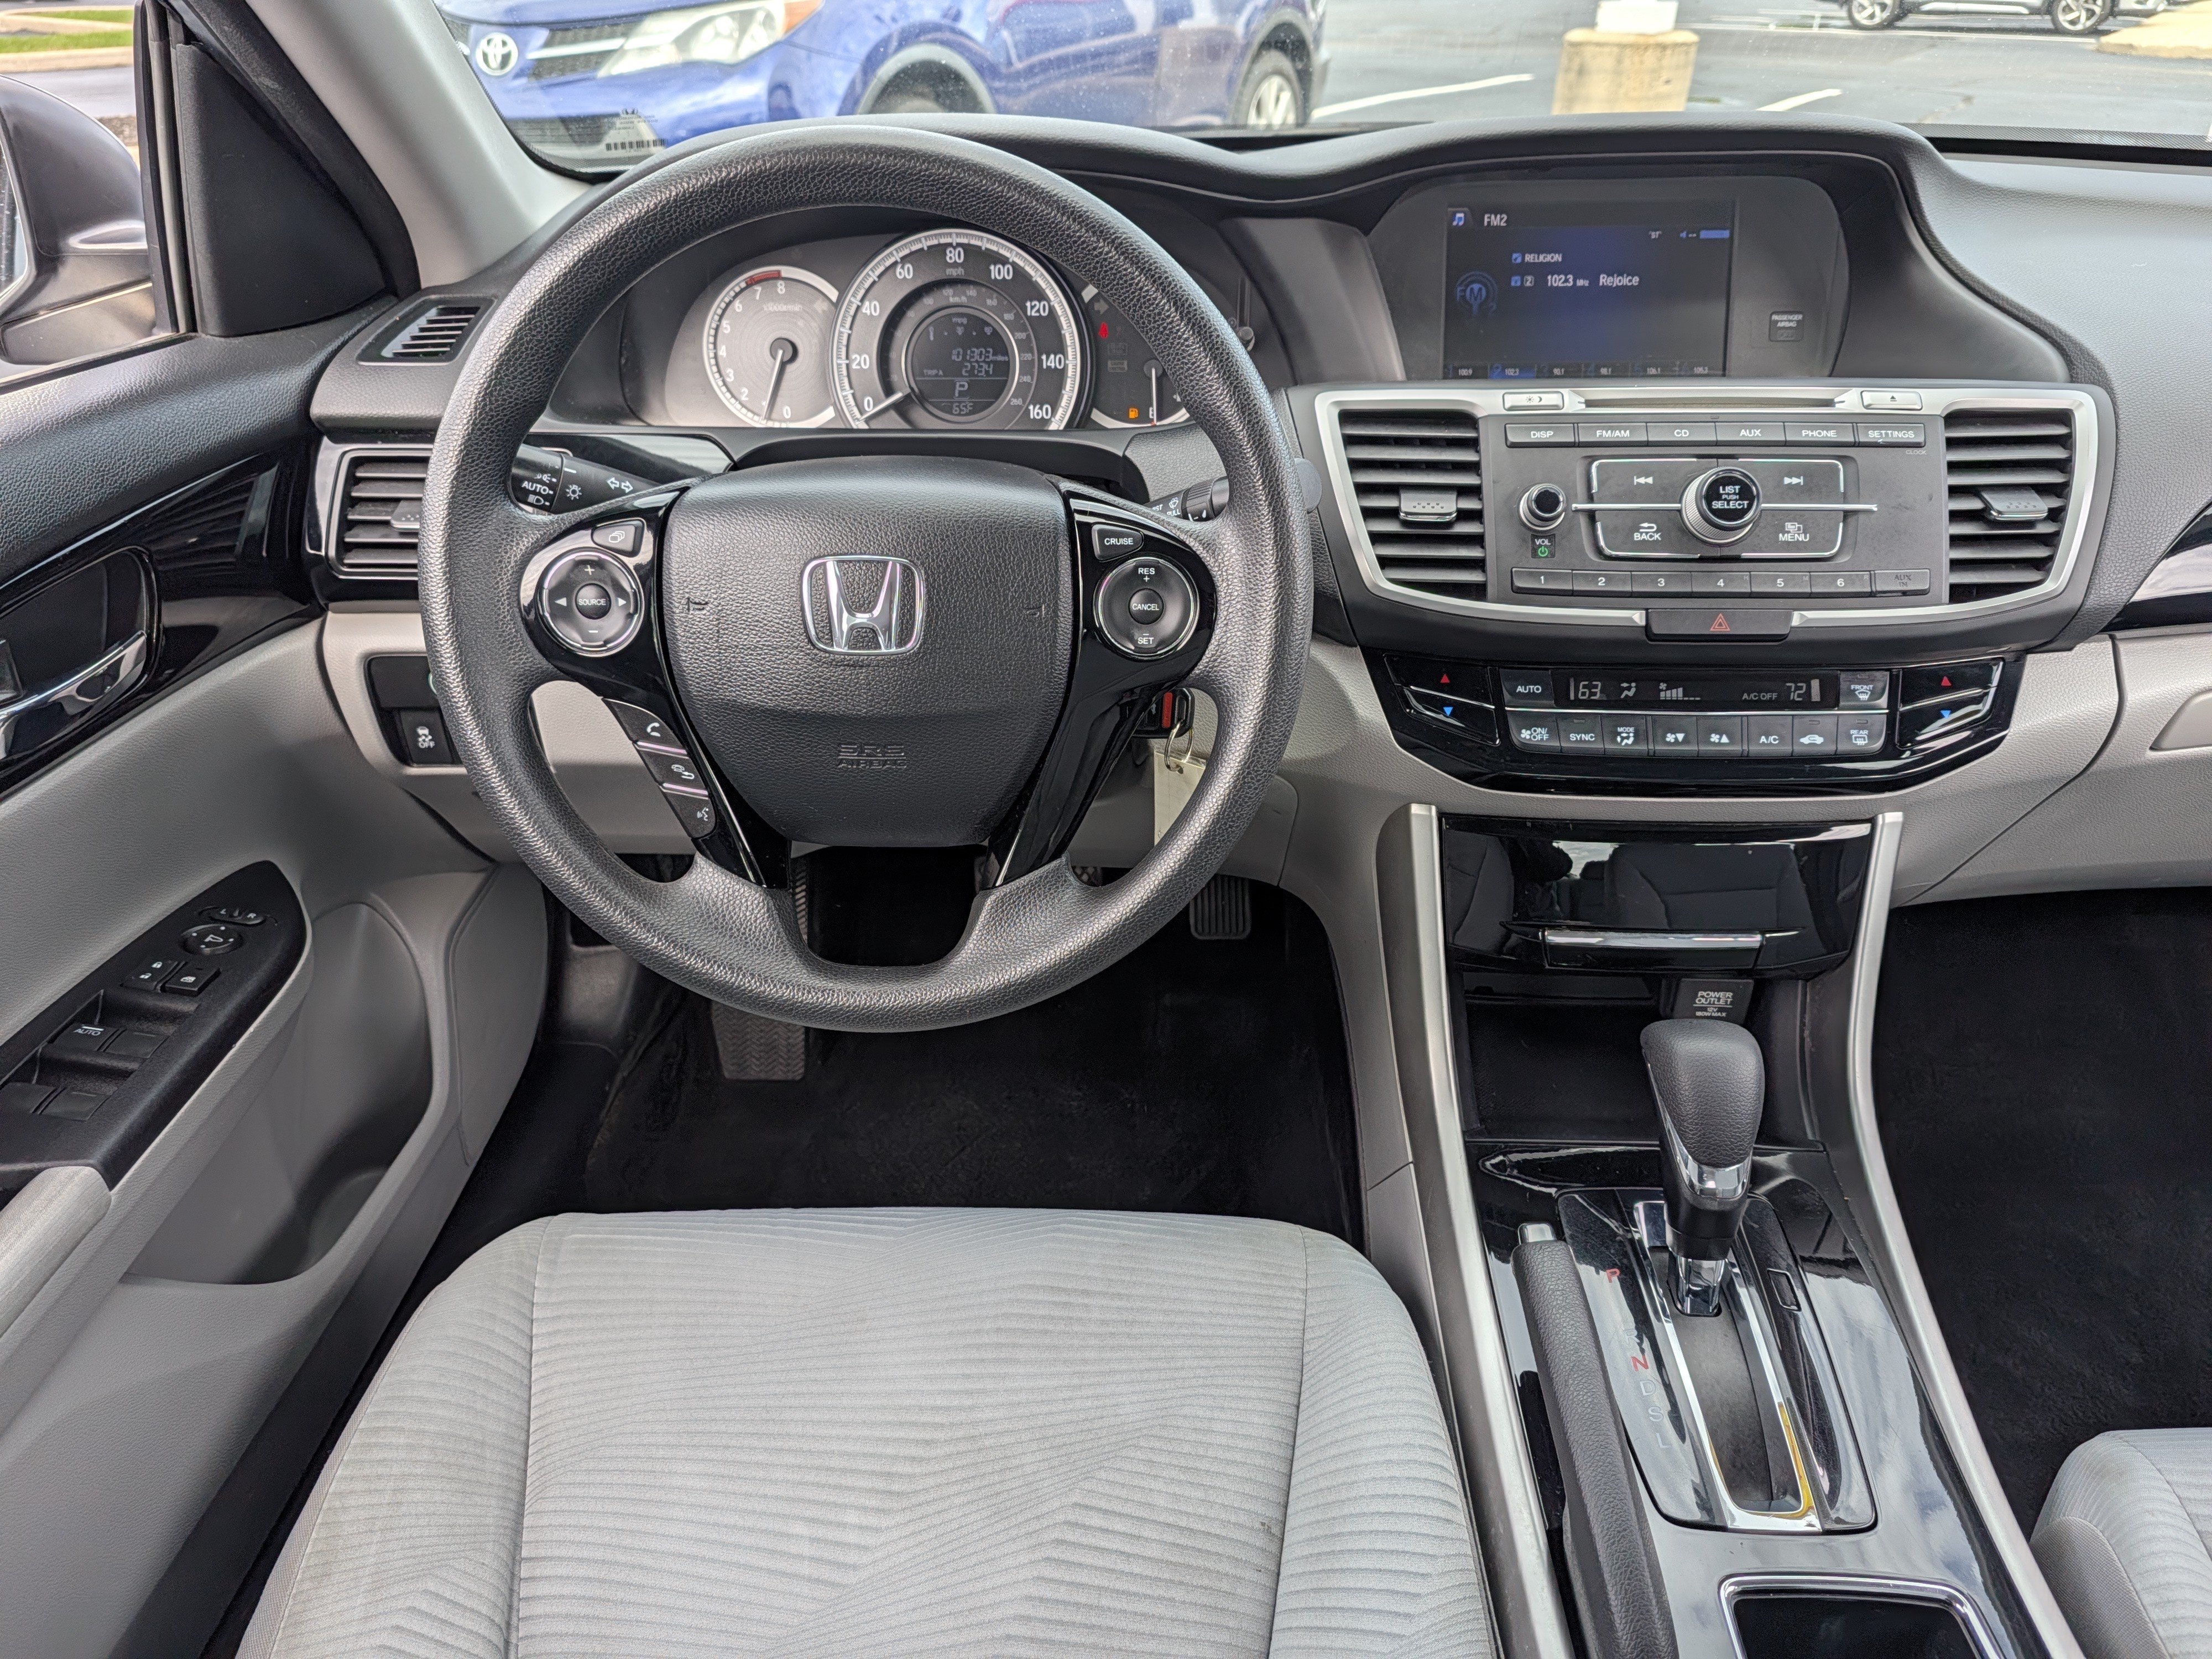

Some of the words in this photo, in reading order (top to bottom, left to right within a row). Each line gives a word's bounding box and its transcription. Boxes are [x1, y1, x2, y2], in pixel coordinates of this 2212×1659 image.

[1484, 213, 1507, 226] FM2
[946, 248, 964, 263] 80
[1525, 253, 1562, 263] RELIGION
[896, 263, 912, 279] 60
[946, 267, 964, 276] mph
[989, 264, 1013, 280] 100
[777, 280, 785, 294] 8
[1547, 274, 1573, 286] 102.3
[1599, 274, 1640, 288] Rejoice
[754, 286, 762, 300] 7
[735, 300, 742, 312] 6
[862, 301, 879, 316] 40
[1025, 300, 1048, 316] 120
[723, 321, 731, 333] 5
[719, 346, 726, 357] 4
[852, 354, 869, 369] 20
[1041, 354, 1065, 369] 140
[726, 368, 734, 382] 3
[740, 388, 749, 400] 2
[955, 381, 968, 397] P
[864, 397, 873, 411] 0
[782, 405, 791, 419] 0
[1028, 404, 1051, 419] 160
[521, 481, 549, 494] AUTO
[1712, 500, 1749, 509] SELECT
[1104, 538, 1134, 546] CRUISE
[1634, 533, 1662, 541] BACK
[1779, 533, 1809, 541] MENU
[1540, 576, 1545, 584] 1
[1598, 577, 1606, 586] 2
[1657, 578, 1665, 587] 3
[1717, 578, 1725, 587] 4
[1776, 578, 1785, 587] 5
[1837, 578, 1845, 587] 6
[1578, 681, 1601, 699] 63
[1785, 683, 1806, 701] 72
[1760, 735, 1778, 744] A/C
[1606, 1268, 1620, 1283] P
[1625, 1328, 1640, 1344] R
[1631, 1355, 1650, 1372] N
[1640, 1379, 1657, 1396] D
[1648, 1406, 1664, 1422] S
[1656, 1433, 1671, 1448] L
